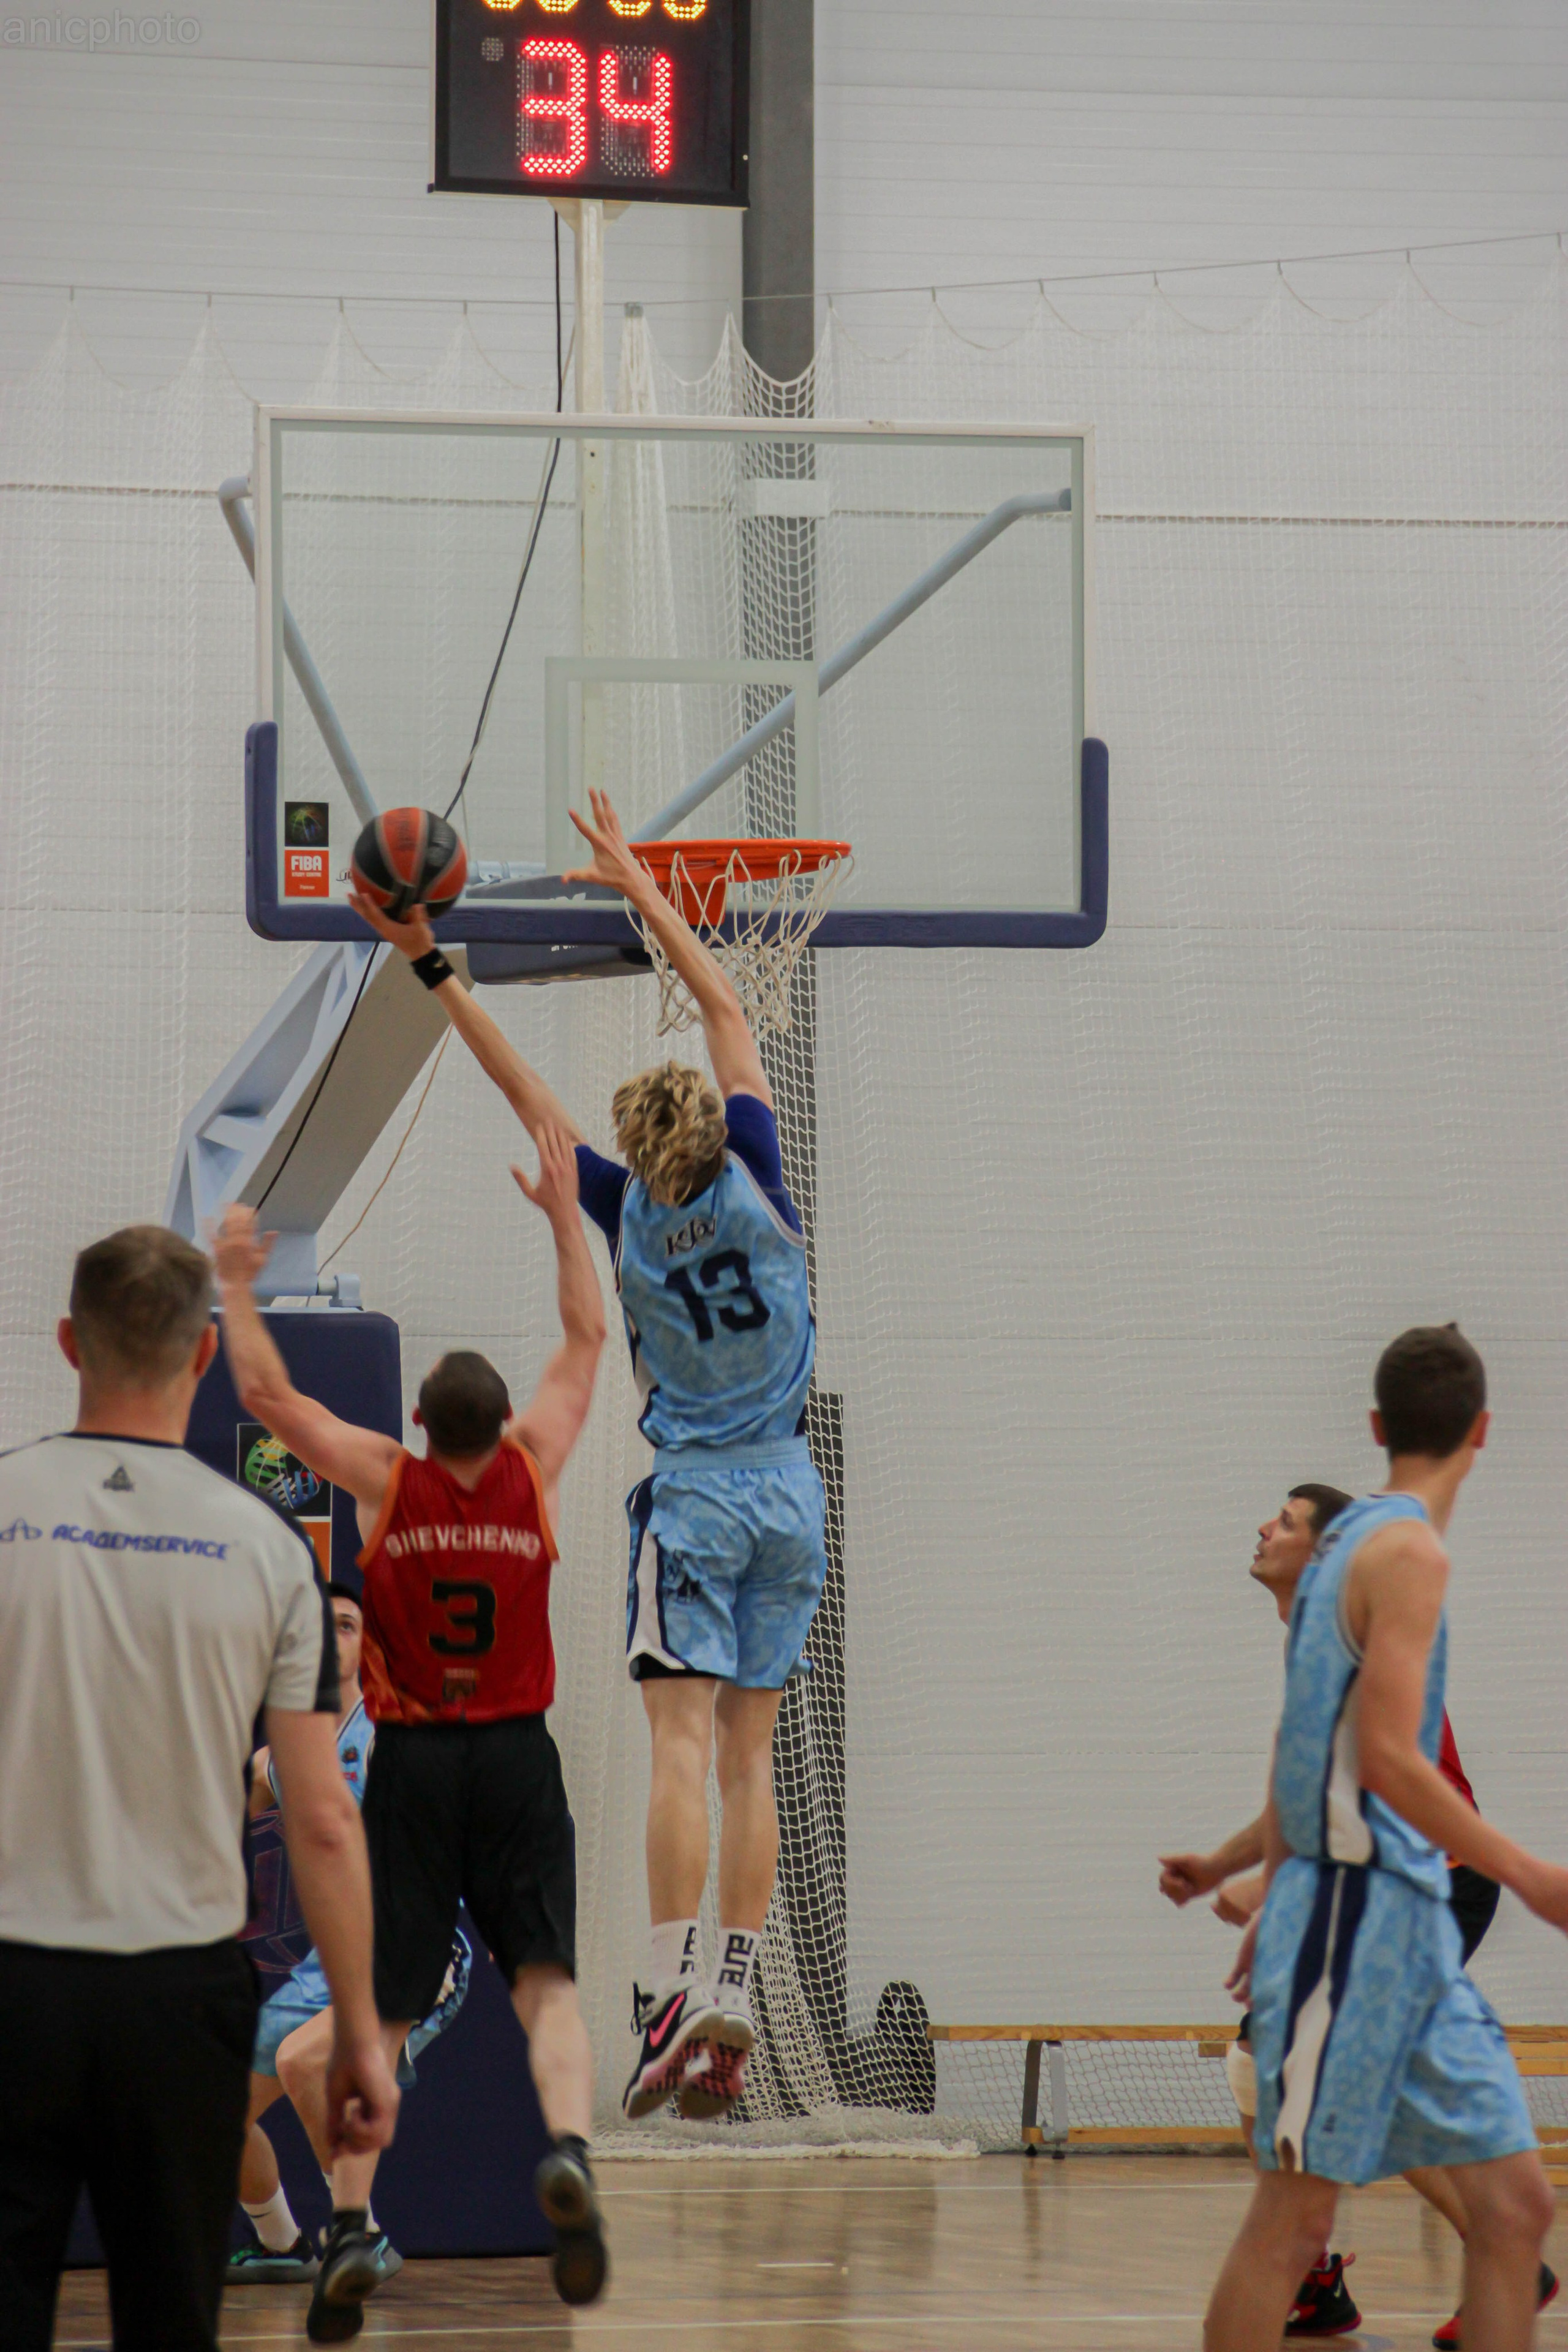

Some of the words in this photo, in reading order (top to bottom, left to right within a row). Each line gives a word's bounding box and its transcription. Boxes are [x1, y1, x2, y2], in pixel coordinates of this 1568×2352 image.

[522, 38, 671, 176] 34
[291, 856, 322, 872] FIBA
[664, 1248, 771, 1343] 13
[51, 1523, 229, 1560] ACADEMSERVICE
[428, 1577, 497, 1655] 3
